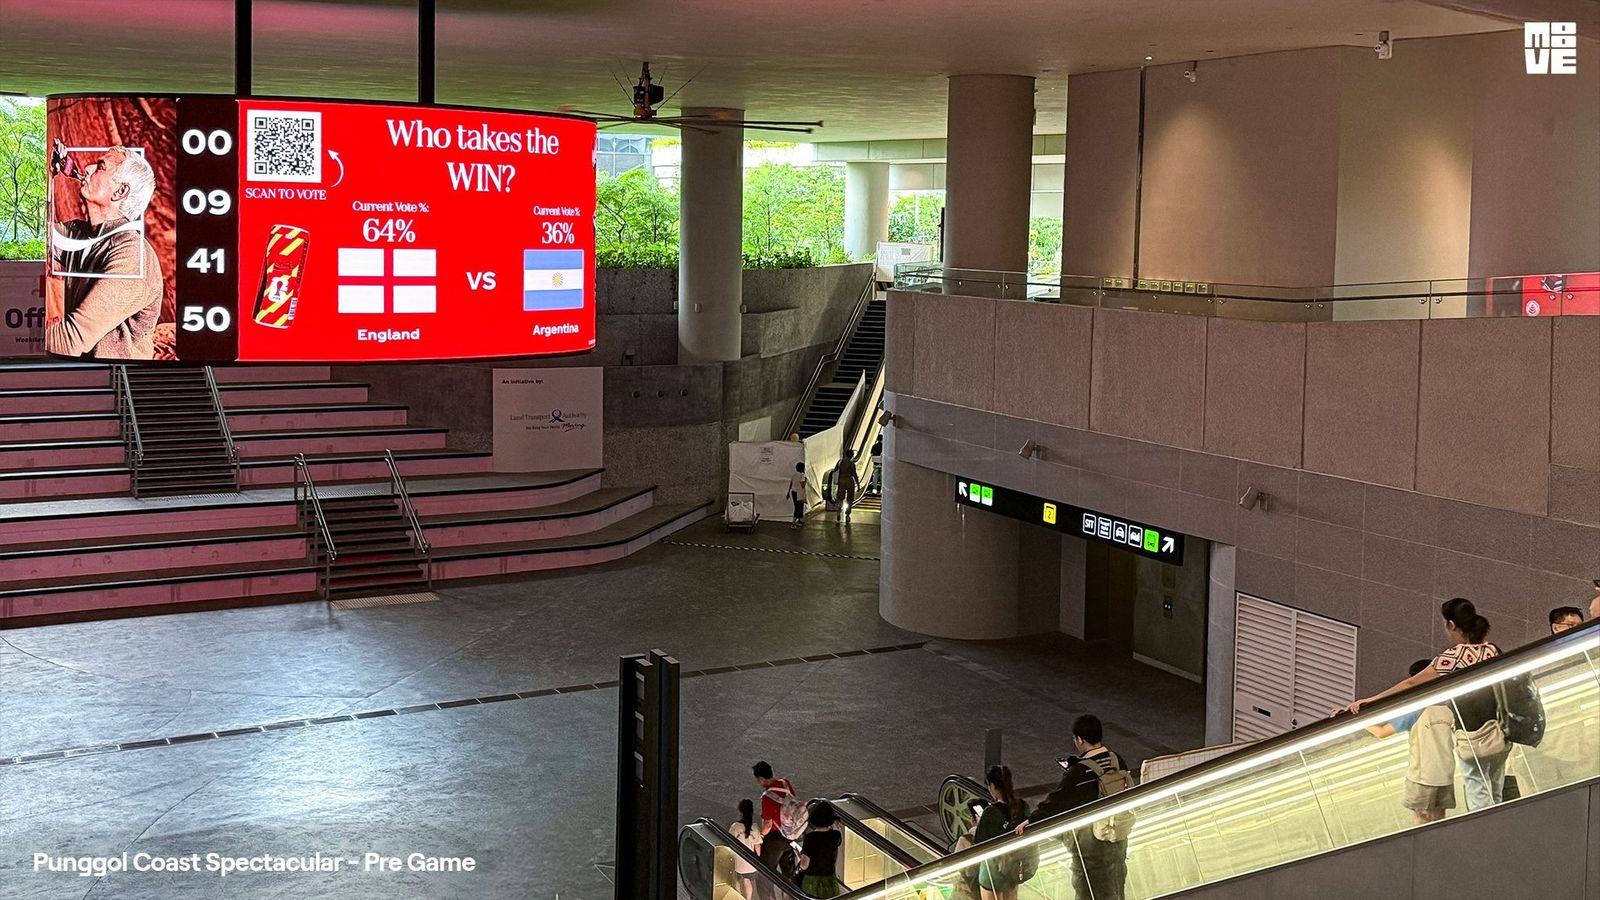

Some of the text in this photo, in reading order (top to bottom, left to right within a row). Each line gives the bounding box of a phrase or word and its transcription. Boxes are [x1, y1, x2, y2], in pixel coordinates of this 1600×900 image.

[182, 128, 233, 156] 00
[386, 119, 560, 155] Who takes the
[446, 162, 516, 193] WIN?
[182, 188, 232, 216] 09
[245, 187, 327, 201] SCAN TO VOTE
[352, 200, 430, 213] Current Vote %:
[533, 205, 561, 216] Current
[561, 206, 575, 217] Vote
[362, 217, 417, 243] 64%
[541, 221, 576, 244] 36%
[186, 247, 226, 274] 41
[181, 305, 231, 333] 50
[532, 322, 580, 338] Argentina
[356, 328, 421, 343] England
